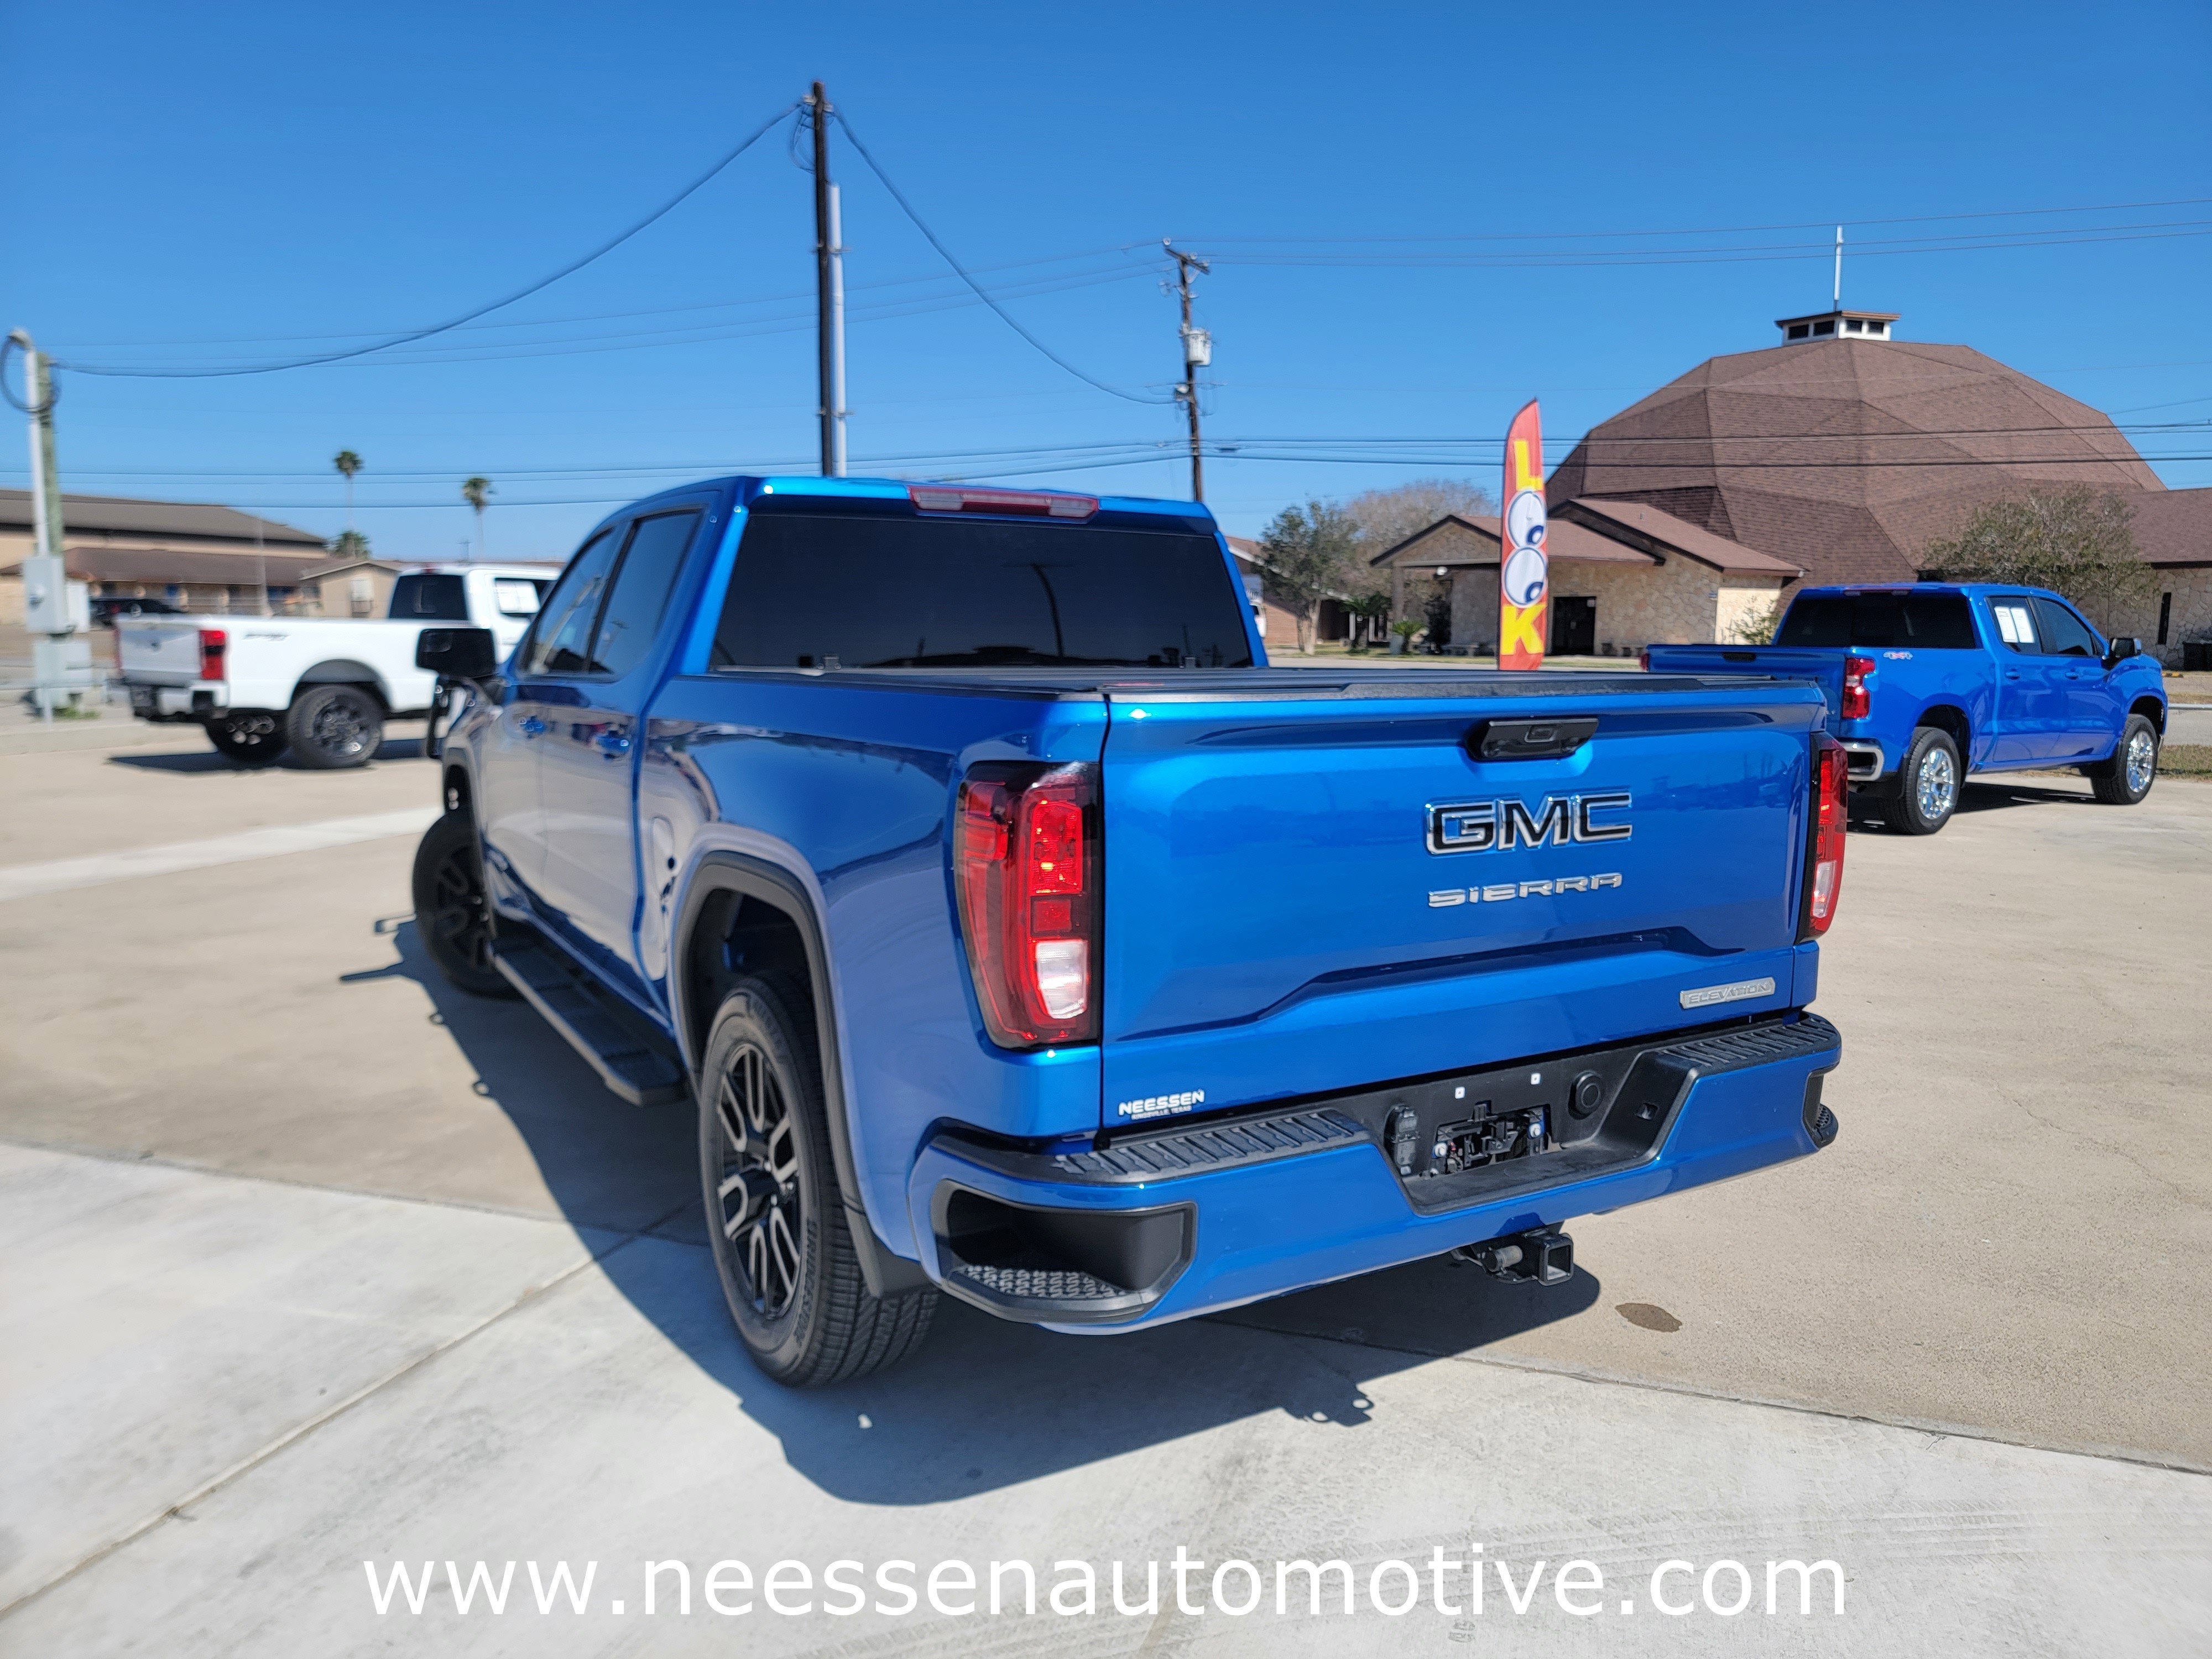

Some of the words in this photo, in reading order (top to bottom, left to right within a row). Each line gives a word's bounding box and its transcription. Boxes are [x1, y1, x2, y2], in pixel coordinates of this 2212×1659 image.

[1425, 791, 1632, 855] GMC
[1428, 872, 1623, 908] SIERRA
[1688, 982, 1771, 1004] ELEVATION
[1118, 1089, 1205, 1116] NEESSEN
